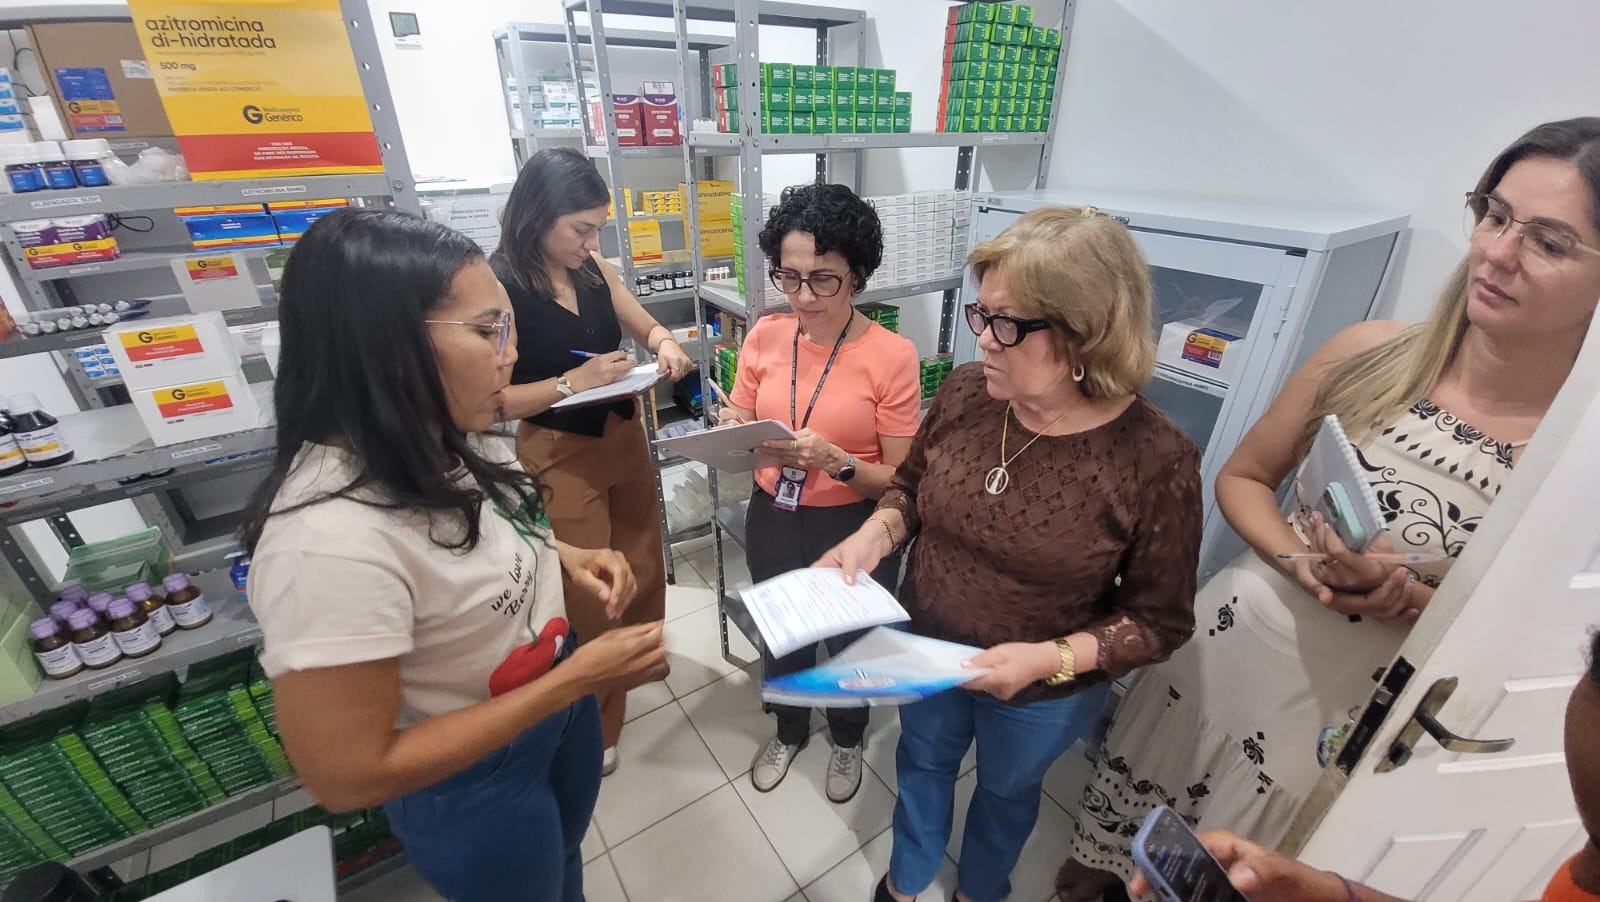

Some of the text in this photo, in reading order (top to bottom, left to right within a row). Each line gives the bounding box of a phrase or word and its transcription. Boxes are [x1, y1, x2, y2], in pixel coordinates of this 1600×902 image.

[145, 15, 265, 32] azitromicina
[151, 33, 277, 49] di-hidratada
[160, 61, 197, 71] 500 mg
[491, 552, 523, 611] we love
